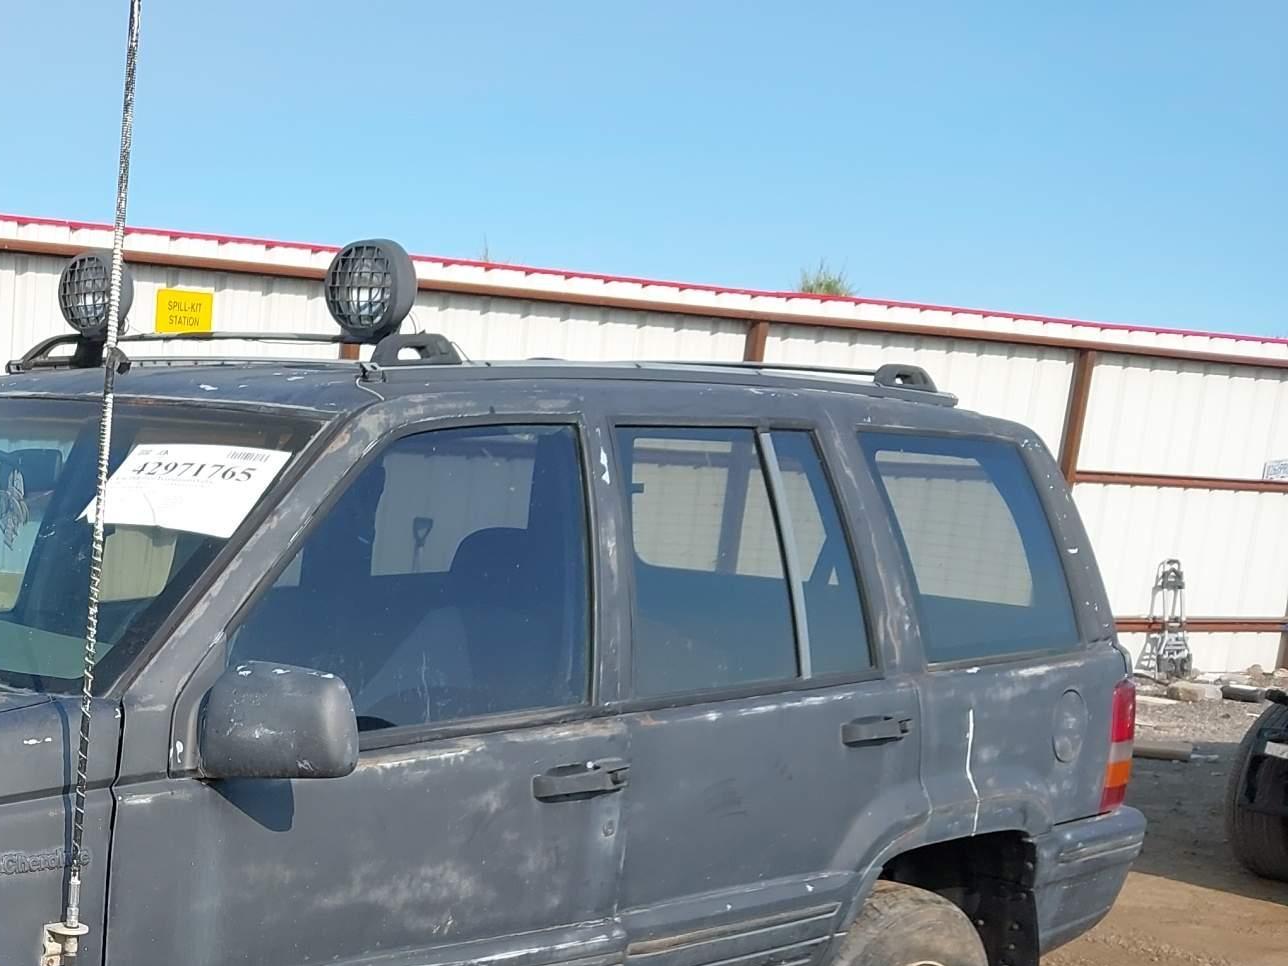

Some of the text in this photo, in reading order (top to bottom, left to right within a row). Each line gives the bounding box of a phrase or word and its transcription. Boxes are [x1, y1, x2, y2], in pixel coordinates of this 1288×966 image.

[167, 300, 202, 313] SPILL-KIT
[168, 314, 200, 327] STATION
[131, 460, 257, 483] 42971765
